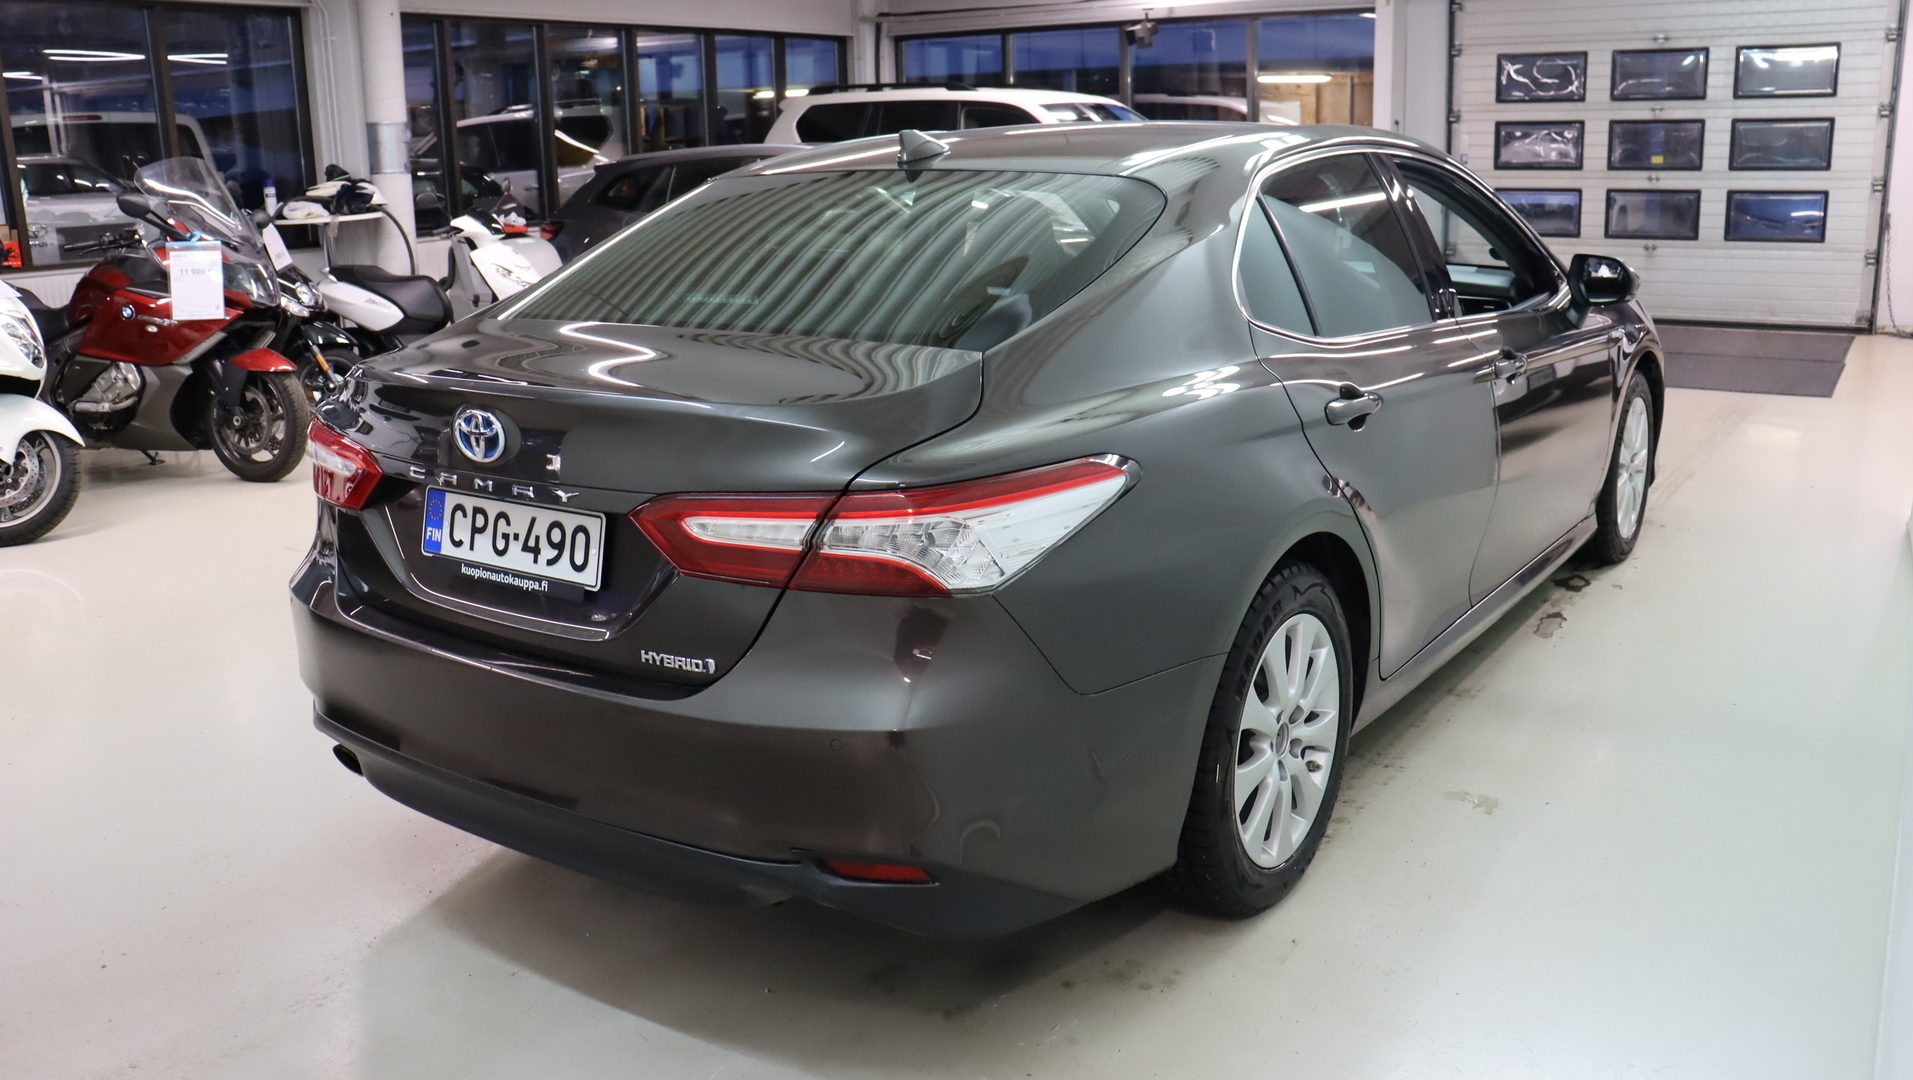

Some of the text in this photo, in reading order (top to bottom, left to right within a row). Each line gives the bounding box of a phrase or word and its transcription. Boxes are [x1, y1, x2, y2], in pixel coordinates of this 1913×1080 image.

[409, 465, 581, 503] CAMRY
[426, 526, 442, 543] FIN
[449, 502, 592, 573] CPG-490
[461, 563, 548, 592] kuopionautokauppa.fi
[641, 649, 703, 673] HYBRID
